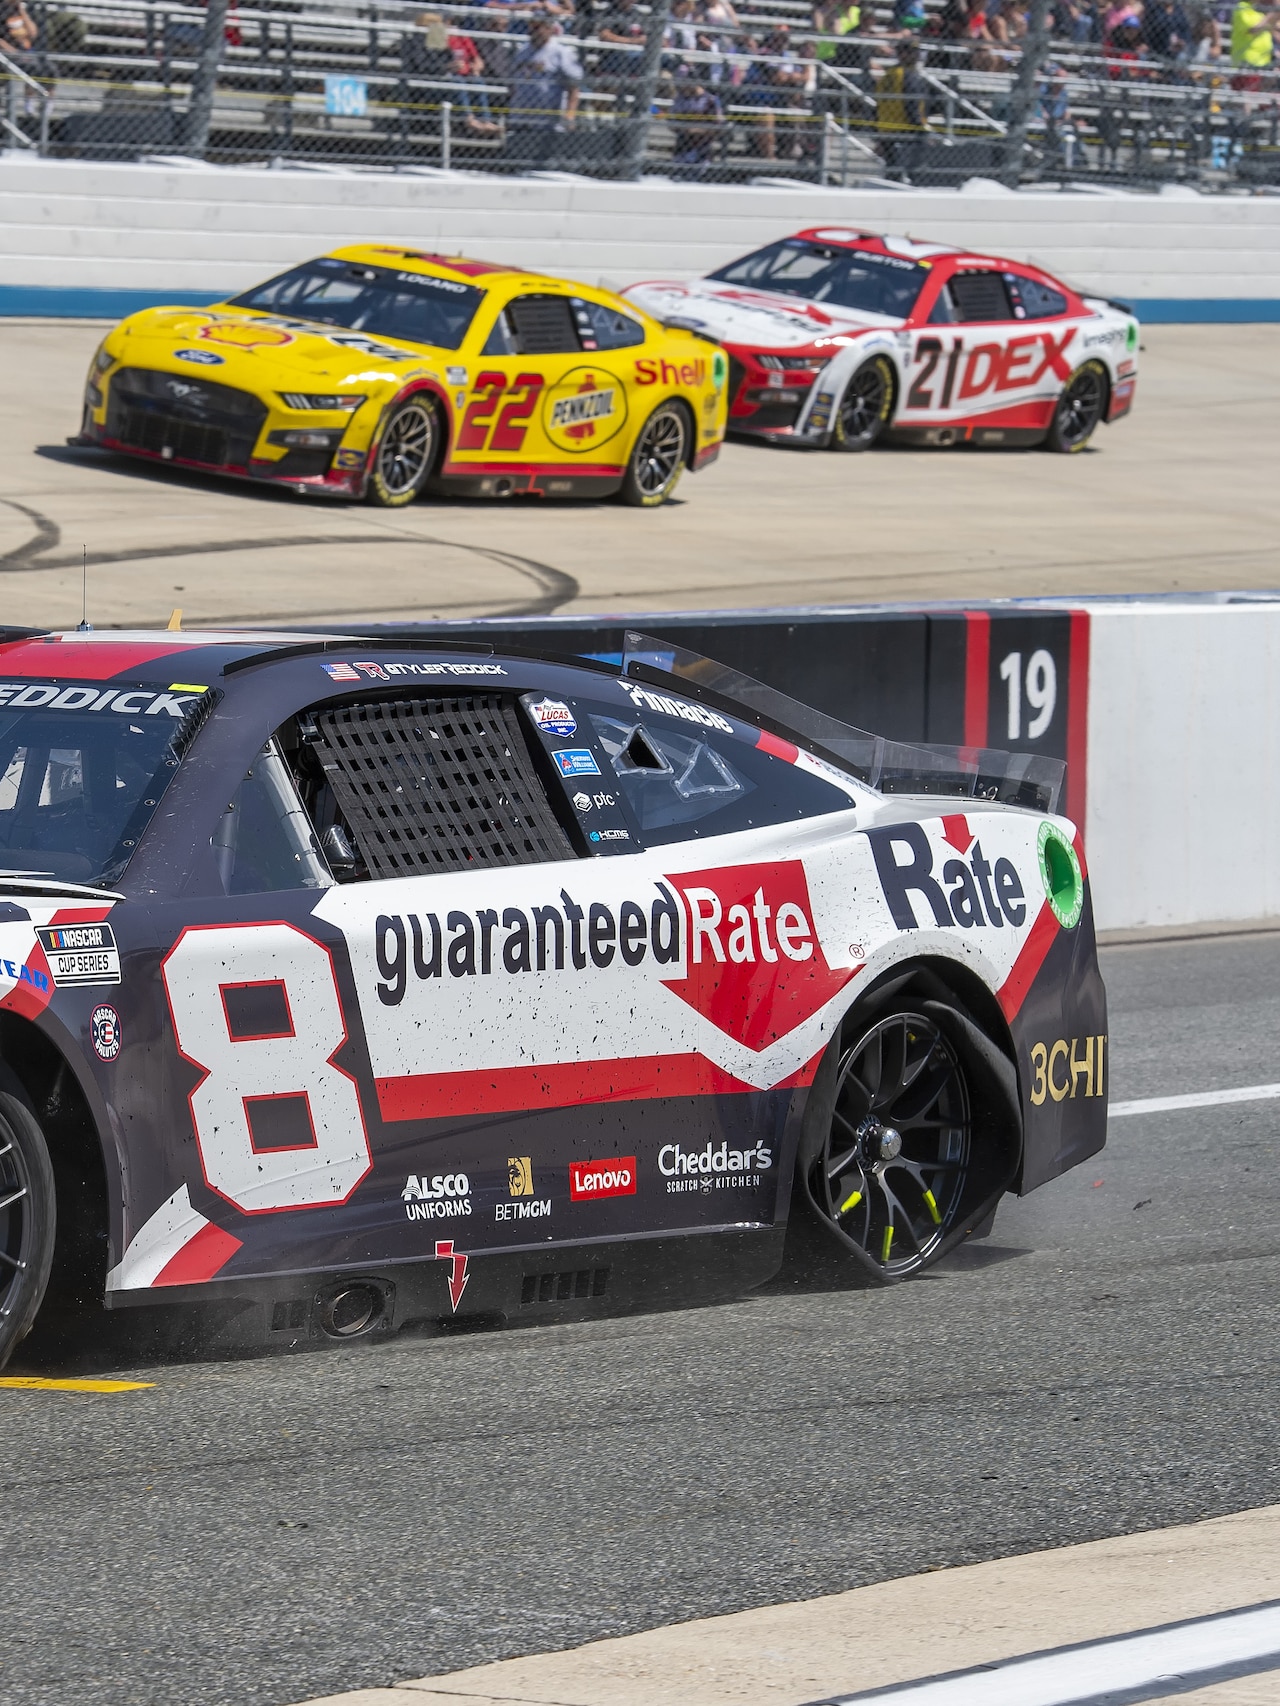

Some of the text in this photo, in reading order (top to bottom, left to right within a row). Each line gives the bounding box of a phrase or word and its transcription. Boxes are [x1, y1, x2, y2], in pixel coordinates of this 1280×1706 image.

[852, 250, 915, 271] BURTON
[396, 271, 467, 294] LOGANO
[635, 358, 706, 387] Shell
[905, 334, 964, 410] 21
[957, 325, 1079, 401] DEX
[455, 371, 545, 451] 22
[549, 387, 616, 429] PENNZOIL
[616, 680, 735, 734] Pinnacle
[999, 648, 1057, 741] 19
[541, 709, 570, 721] LUCAS
[592, 791, 616, 810] ptc
[864, 822, 1028, 932] Rate
[61, 928, 104, 948] NASCAR
[58, 954, 110, 973] CUP SERIES
[93, 1008, 118, 1027] NASCAR
[94, 1038, 120, 1058] SALUTES
[161, 920, 375, 1216] 8
[1029, 1034, 1106, 1106] 3CHI
[657, 1139, 773, 1178] Cheddar's
[574, 1168, 631, 1193] Lenovo
[666, 1174, 761, 1194] SCRATCH KITCHEN
[405, 1198, 473, 1221] UNIFORMS
[495, 1199, 552, 1222] BETMGM
